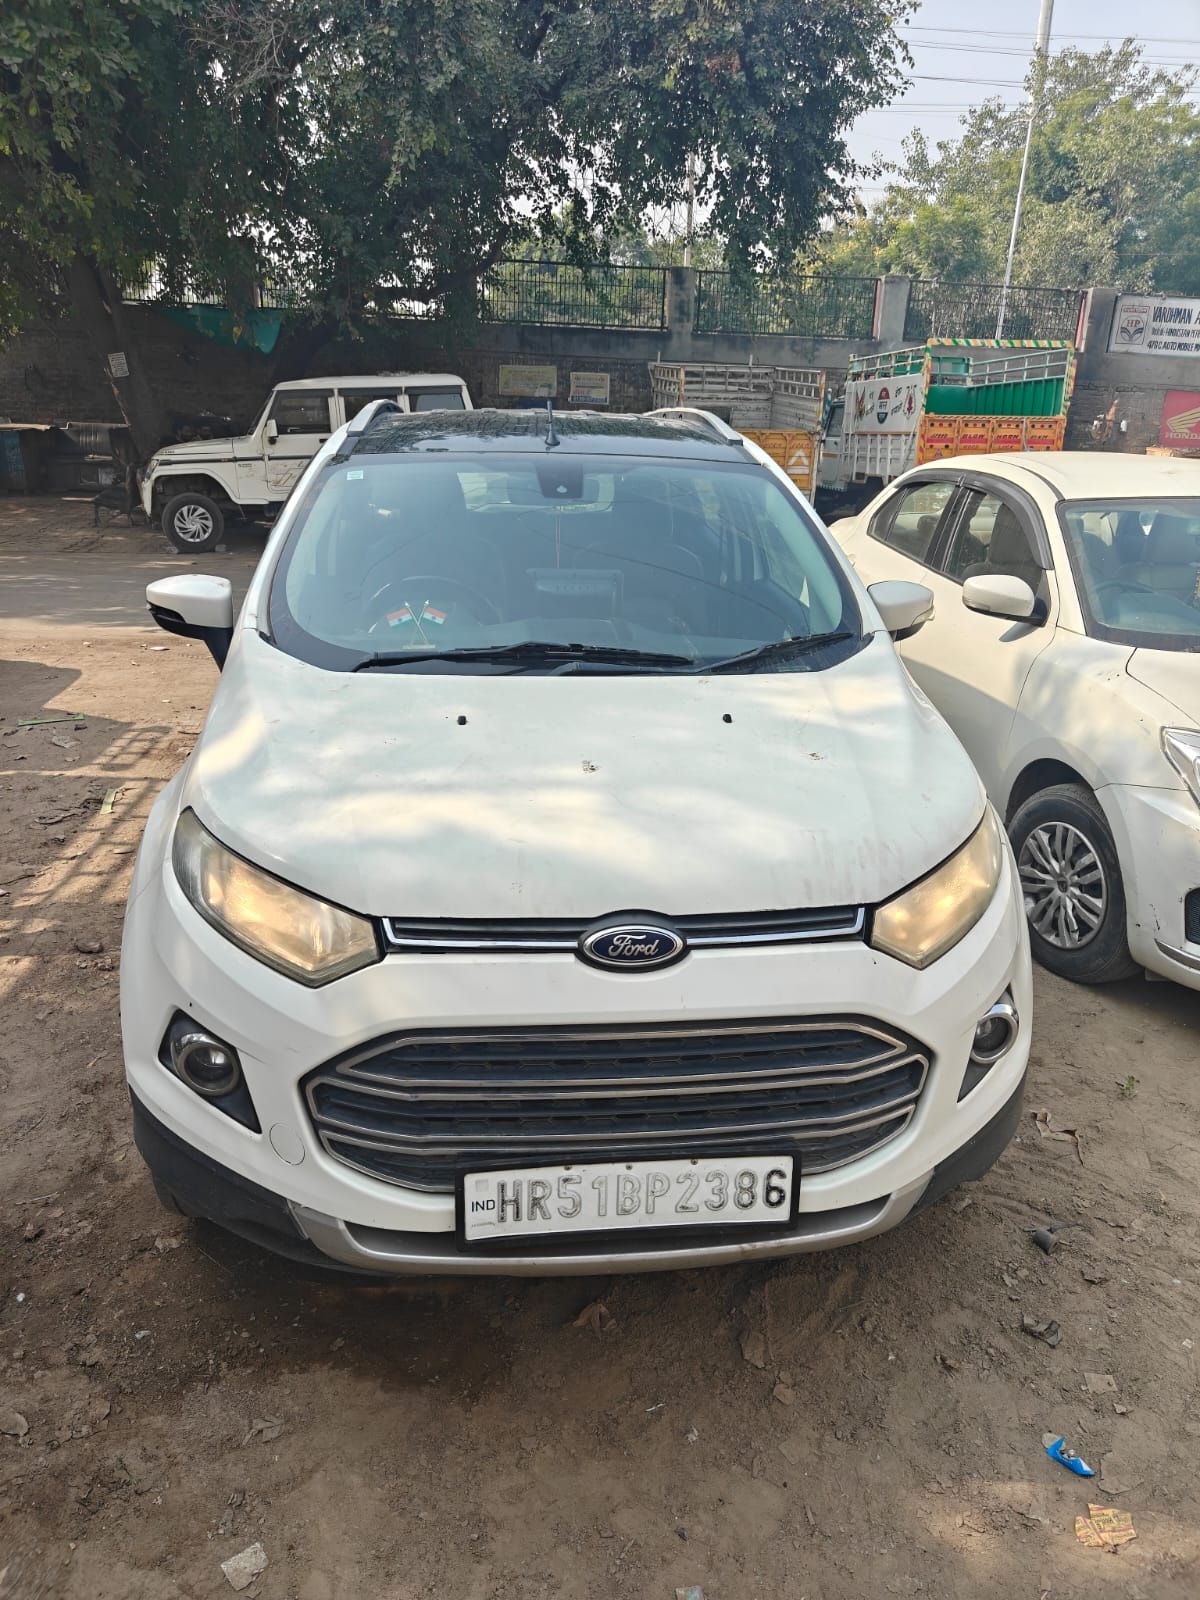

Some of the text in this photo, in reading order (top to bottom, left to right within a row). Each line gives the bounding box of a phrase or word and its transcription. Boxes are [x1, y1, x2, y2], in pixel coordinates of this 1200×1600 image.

[1127, 319, 1141, 327] HP
[1152, 306, 1193, 324] VARDHMAN
[608, 934, 660, 957] Ford
[497, 1168, 787, 1223] HR51BP2386
[471, 1199, 496, 1212] IND
